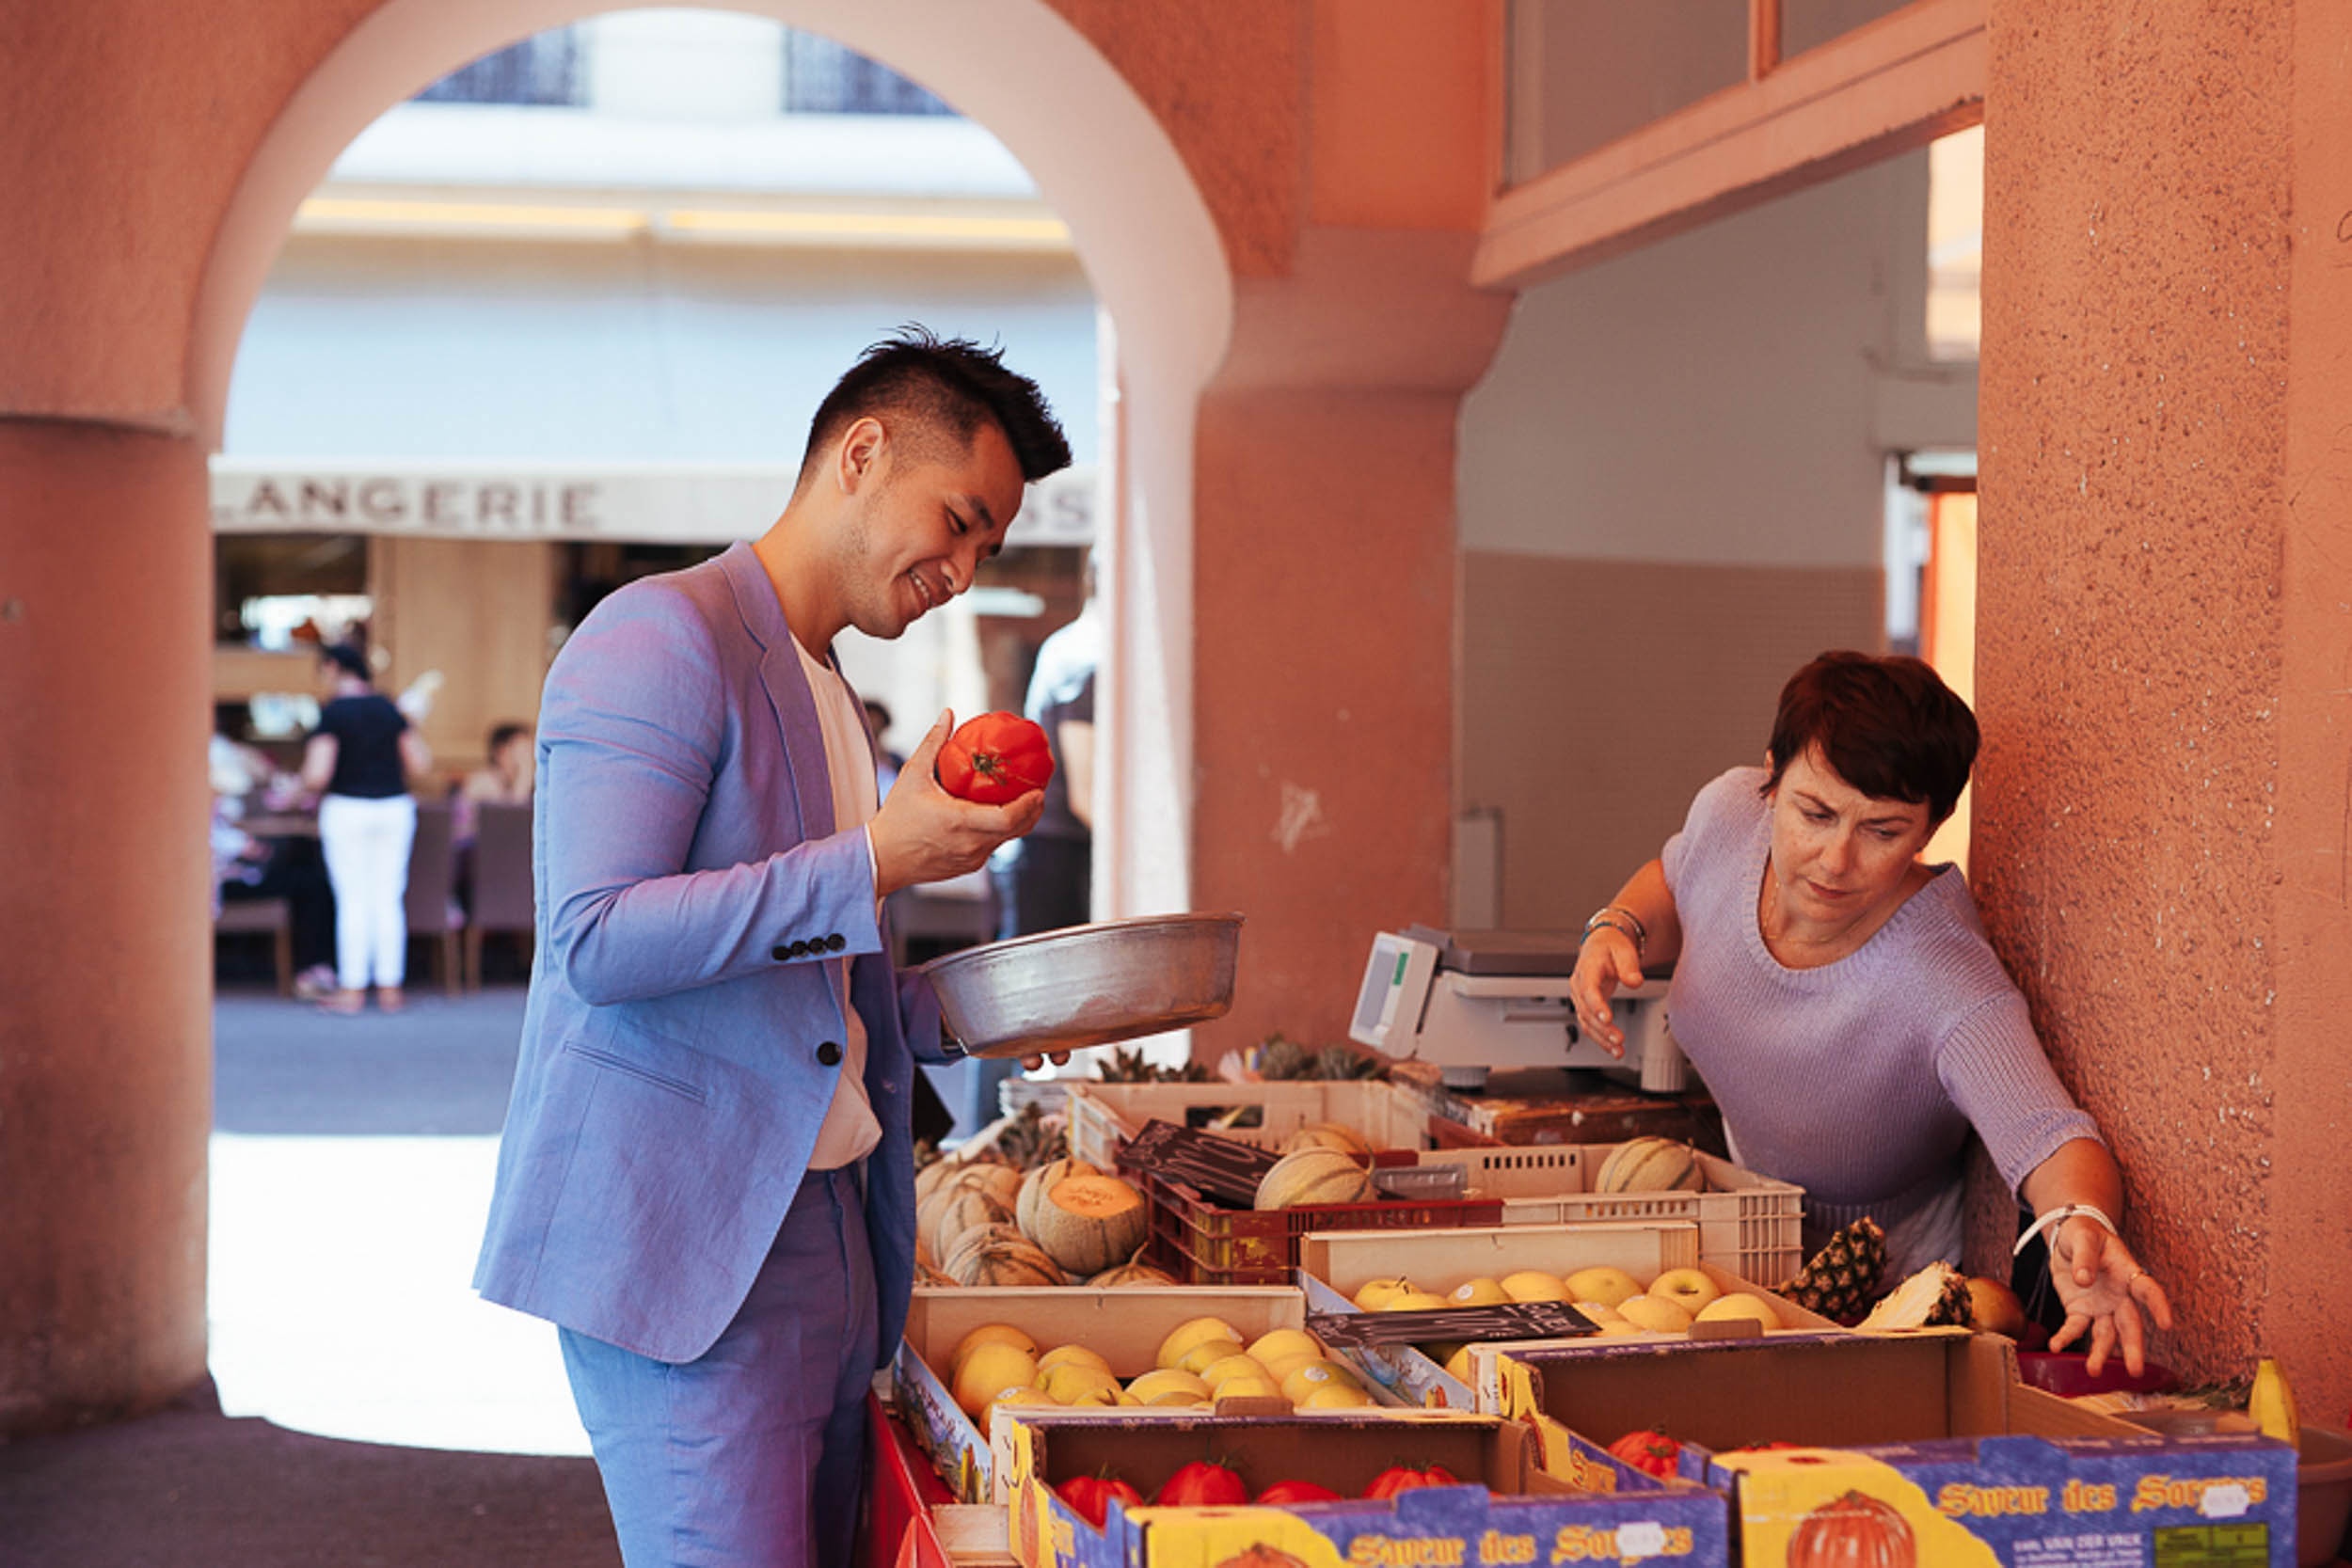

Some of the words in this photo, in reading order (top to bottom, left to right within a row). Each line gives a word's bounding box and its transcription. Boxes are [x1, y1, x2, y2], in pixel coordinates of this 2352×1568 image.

[215, 475, 602, 528] ANGERIE
[2061, 1479, 2115, 1513] des
[1480, 1528, 1536, 1564] des
